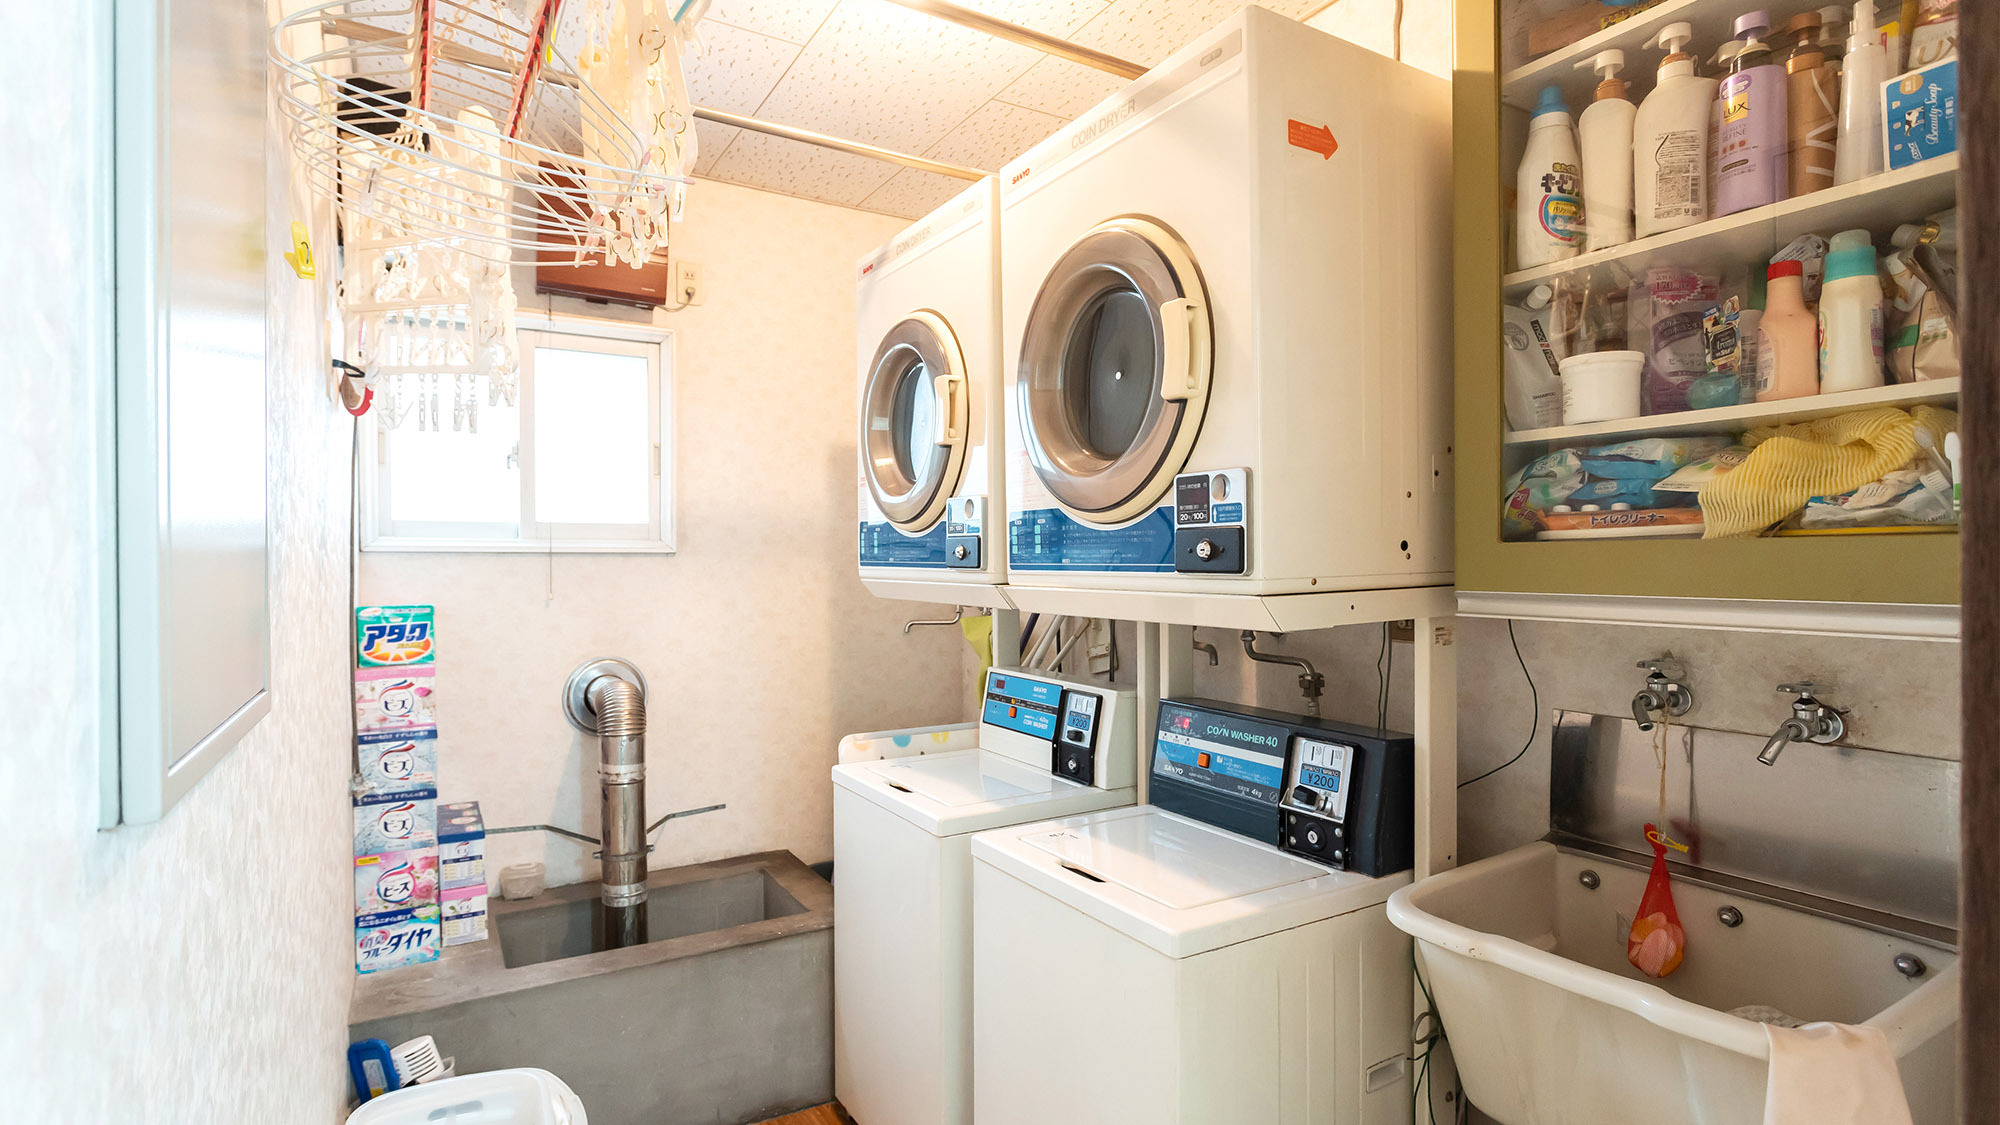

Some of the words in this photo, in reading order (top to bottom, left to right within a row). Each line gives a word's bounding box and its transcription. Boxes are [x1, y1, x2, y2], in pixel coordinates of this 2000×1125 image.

[1924, 83, 1942, 108] Soap
[1723, 102, 1751, 119] LUX
[1926, 107, 1943, 145] Beauty
[1071, 122, 1097, 150] COIN
[1591, 513, 1665, 526] トイレクリーナー
[363, 622, 429, 652] アタック
[384, 698, 409, 712] ビーズ
[1072, 717, 1088, 729] ¥200
[1207, 725, 1229, 738] COIN
[1231, 730, 1265, 745] WASHER
[1265, 735, 1279, 748] 40
[384, 759, 410, 774] ビーズ
[1308, 772, 1335, 789] ¥200
[1251, 788, 1262, 798] 4kg
[384, 818, 410, 833] ビーズ
[362, 927, 433, 960] ブルーダイヤ
